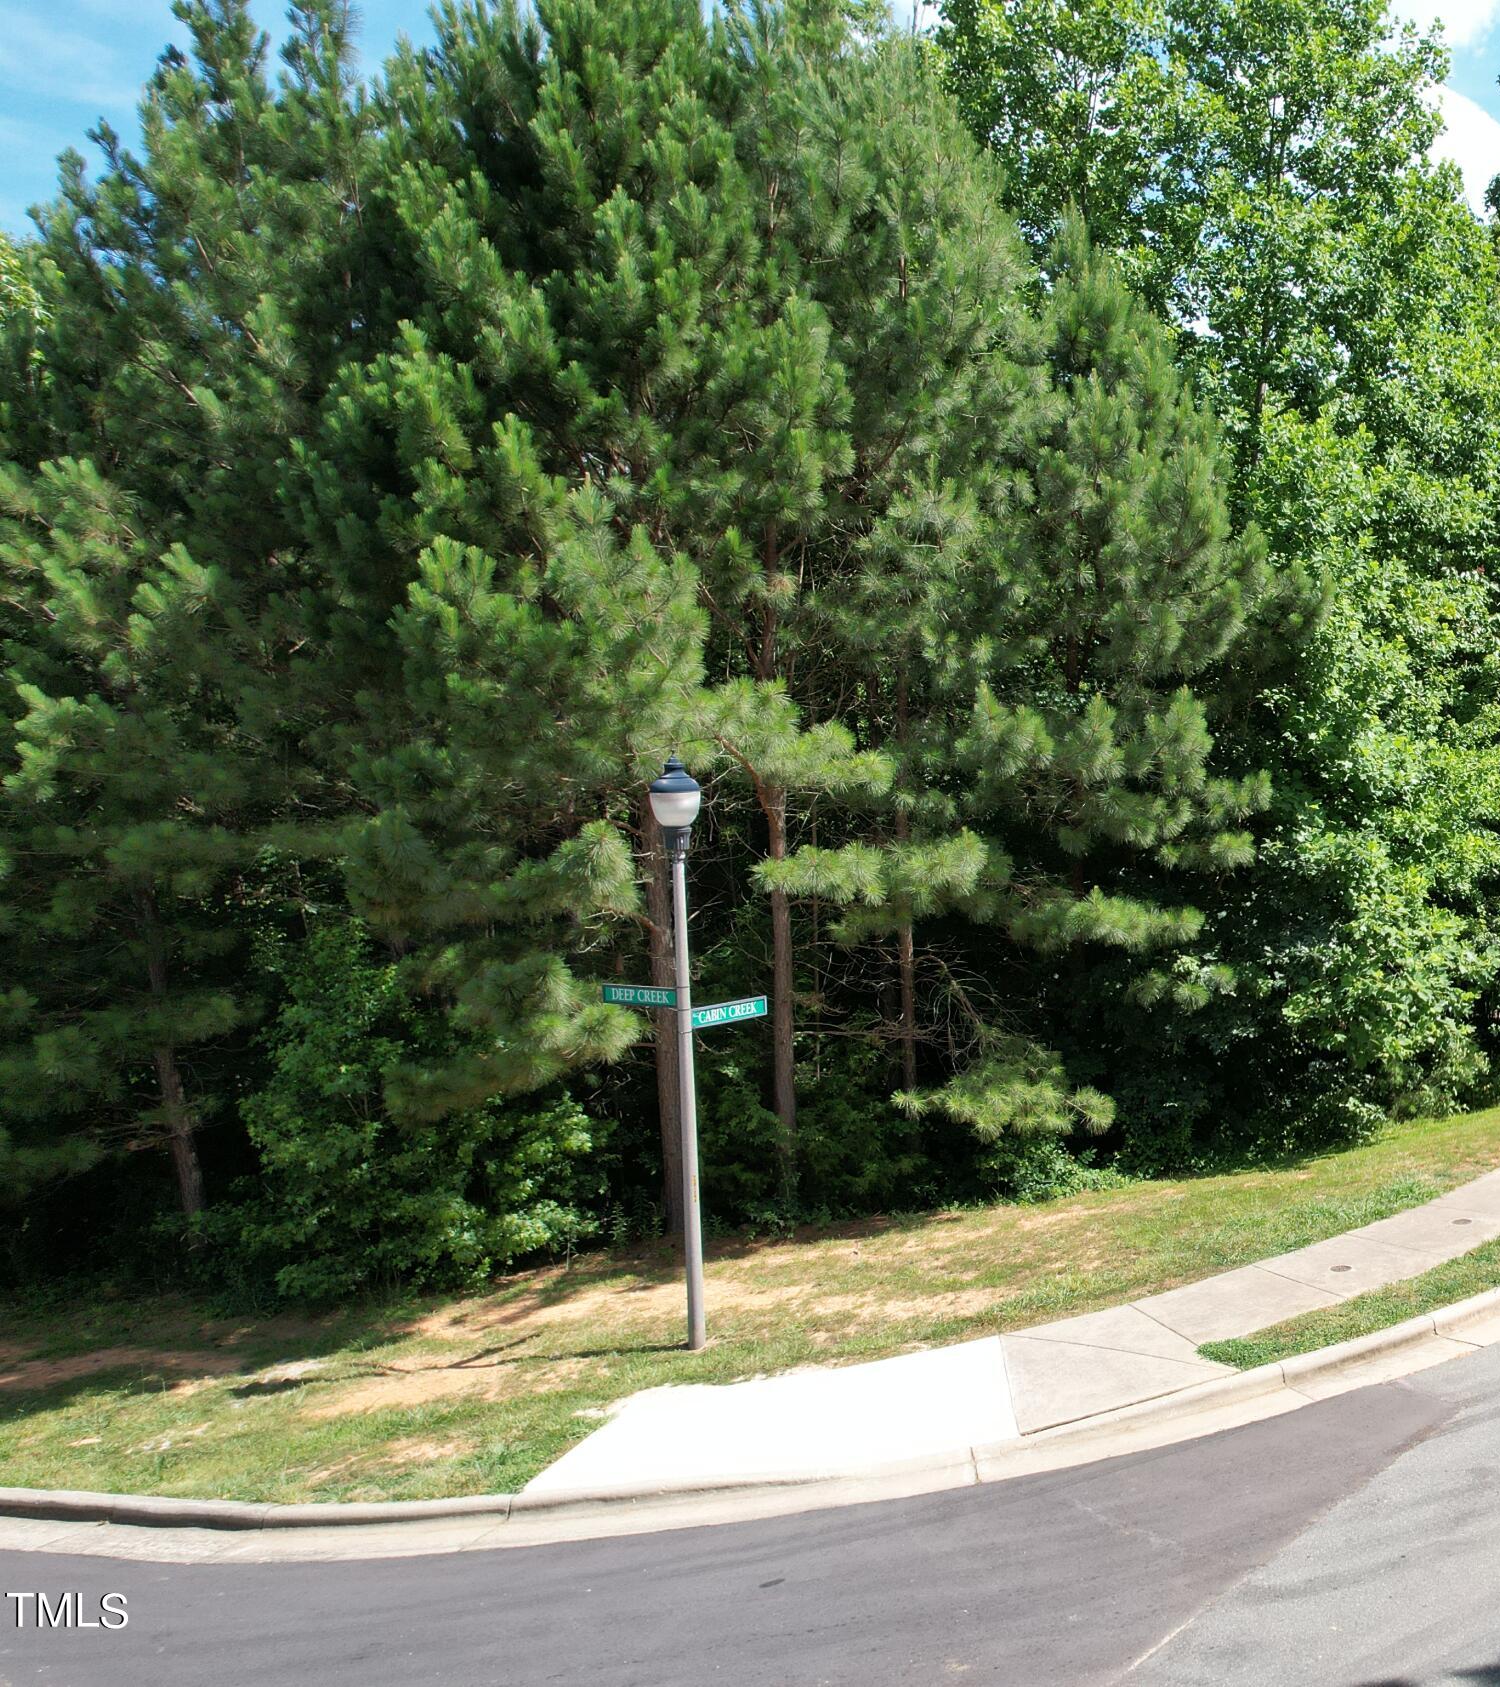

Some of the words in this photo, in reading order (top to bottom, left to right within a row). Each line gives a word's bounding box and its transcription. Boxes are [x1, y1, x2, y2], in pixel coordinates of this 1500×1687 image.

[611, 987, 635, 1001] DEEP
[637, 989, 670, 1004] CREEK
[698, 1006, 728, 1023] CABIN
[728, 1001, 757, 1018] CREEK
